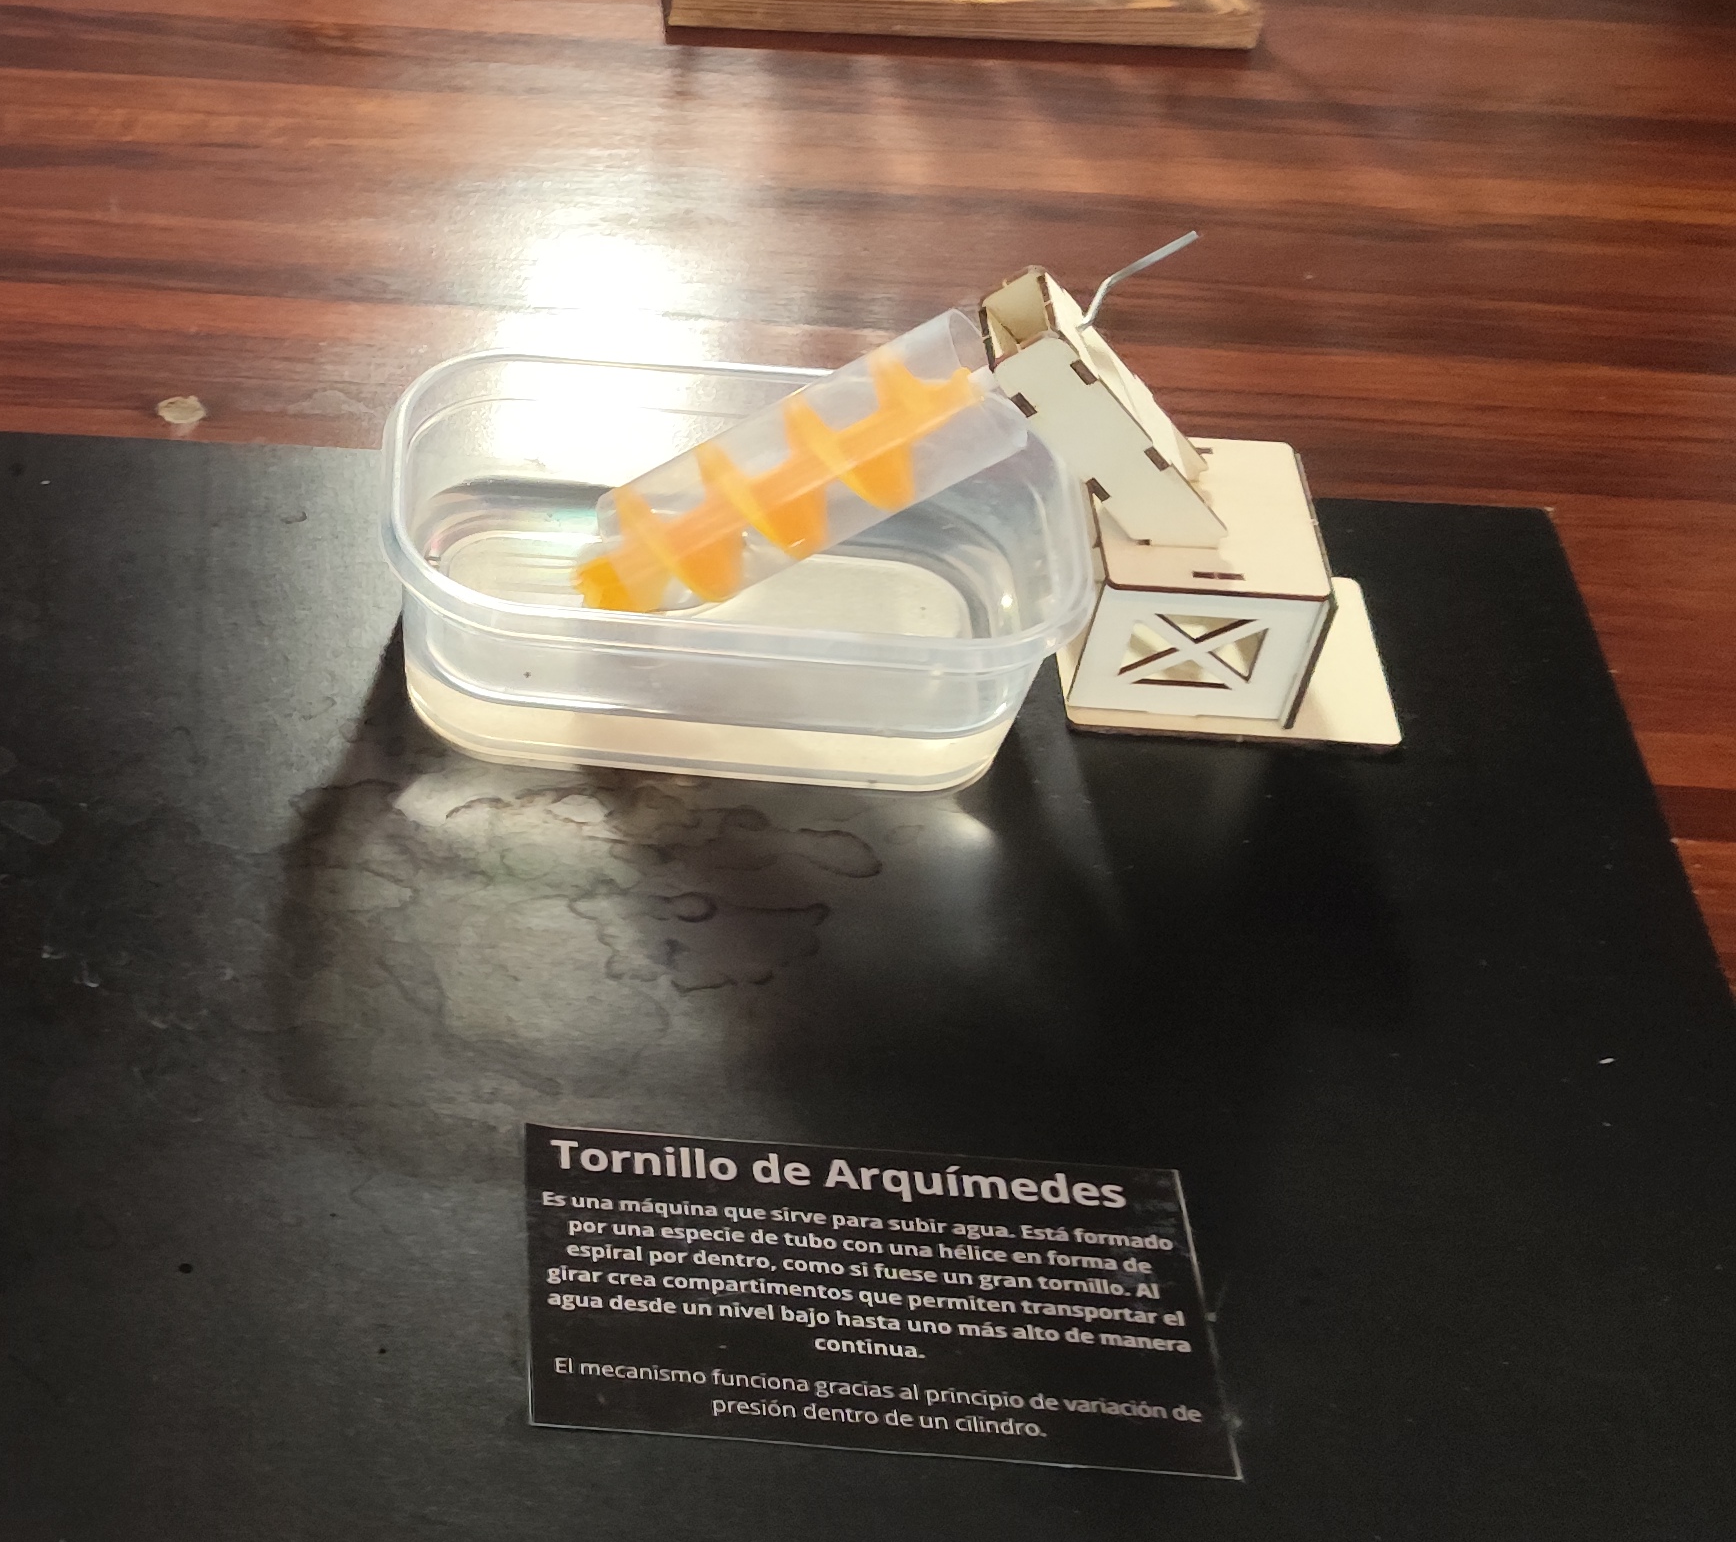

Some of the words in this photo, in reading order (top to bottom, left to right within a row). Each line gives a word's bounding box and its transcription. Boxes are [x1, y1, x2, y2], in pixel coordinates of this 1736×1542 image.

[550, 1139, 738, 1181] Tornillo
[752, 1152, 811, 1186] de
[824, 1158, 1127, 1208] Arquímedes
[541, 1191, 566, 1207] Es
[571, 1195, 614, 1211] una
[618, 1198, 718, 1218] máquina
[723, 1207, 767, 1222] que
[770, 1206, 826, 1225] sirve
[832, 1213, 884, 1230] para
[887, 1217, 948, 1234] subir
[951, 1222, 1017, 1240] agua.
[1021, 1224, 1069, 1242] Está
[1073, 1227, 1174, 1251] formado
[568, 1219, 607, 1236] por
[612, 1222, 655, 1238] una
[661, 1226, 745, 1244] especie
[750, 1228, 779, 1245] de
[784, 1231, 837, 1249] tubo
[842, 1238, 884, 1254] con
[888, 1242, 933, 1258] una
[938, 1243, 1007, 1262] hélice
[1012, 1250, 1042, 1266] en
[1047, 1249, 1118, 1271] forma
[1122, 1257, 1153, 1275] de
[546, 1264, 603, 1285] girar
[607, 1270, 656, 1288] crea
[663, 1274, 853, 1301] compartimentos
[858, 1290, 902, 1307] que
[908, 1294, 1017, 1314] permiten
[1021, 1299, 1158, 1325] transportar
[1163, 1310, 1186, 1328] el
[566, 1243, 643, 1262] espiral
[649, 1250, 688, 1266] por
[693, 1249, 777, 1272] dentro,
[782, 1258, 845, 1276] como
[849, 1262, 869, 1278] si
[874, 1262, 938, 1283] fuese
[942, 1269, 973, 1285] un
[978, 1274, 1033, 1290] gran
[1038, 1275, 1131, 1297] tornillo.
[1135, 1282, 1161, 1300] Al
[547, 1292, 603, 1310] agua
[609, 1294, 677, 1314] desde
[682, 1302, 712, 1316] un
[718, 1302, 774, 1321] nivel
[780, 1305, 830, 1328] bajo
[836, 1309, 901, 1331] hasta
[906, 1318, 952, 1335] uno
[957, 1321, 1007, 1338] más
[1012, 1325, 1060, 1343] alto
[1064, 1327, 1096, 1345] de
[1100, 1332, 1192, 1353] manera
[814, 1337, 926, 1359] continua.
[554, 1357, 573, 1374] El
[580, 1361, 707, 1385] mecanismo
[713, 1369, 810, 1393] funciona
[815, 1380, 895, 1399] gracias
[898, 1384, 919, 1401] al
[926, 1387, 1025, 1410] principio
[1029, 1392, 1059, 1411] de
[1063, 1396, 1168, 1419] variación
[1172, 1404, 1203, 1423] de
[712, 1399, 797, 1419] presión
[803, 1403, 879, 1425] dentro
[885, 1409, 914, 1427] de
[919, 1413, 949, 1430] un
[955, 1414, 1047, 1437] cilindro.
